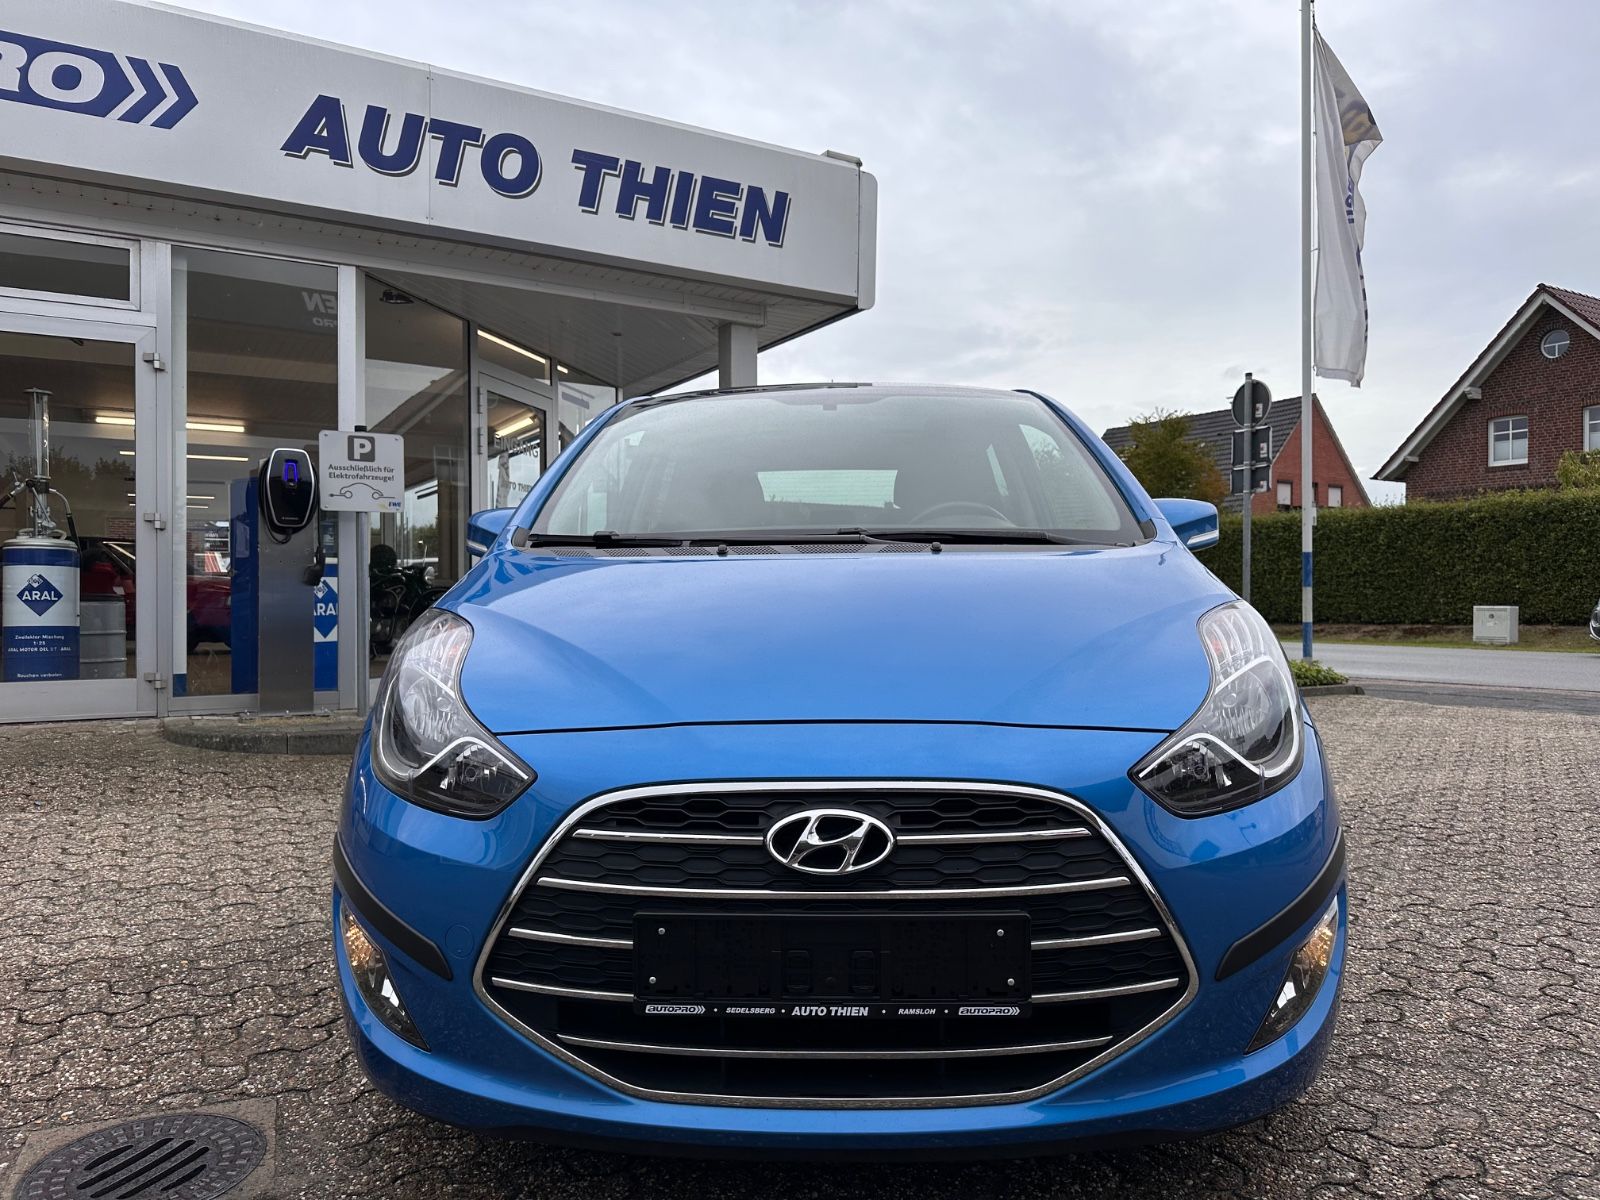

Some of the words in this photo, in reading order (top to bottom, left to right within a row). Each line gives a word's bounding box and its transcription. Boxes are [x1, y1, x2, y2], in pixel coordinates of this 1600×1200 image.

[280, 94, 543, 200] AUTO
[571, 148, 792, 249] THIEN
[353, 438, 372, 460] P
[328, 464, 382, 473] Ausschließlich
[383, 466, 395, 474] für
[328, 472, 395, 483] Elektrofahrzeuge!
[22, 590, 59, 601] ARAL
[791, 1006, 828, 1016] AUTO
[829, 1006, 869, 1016] THIEN
